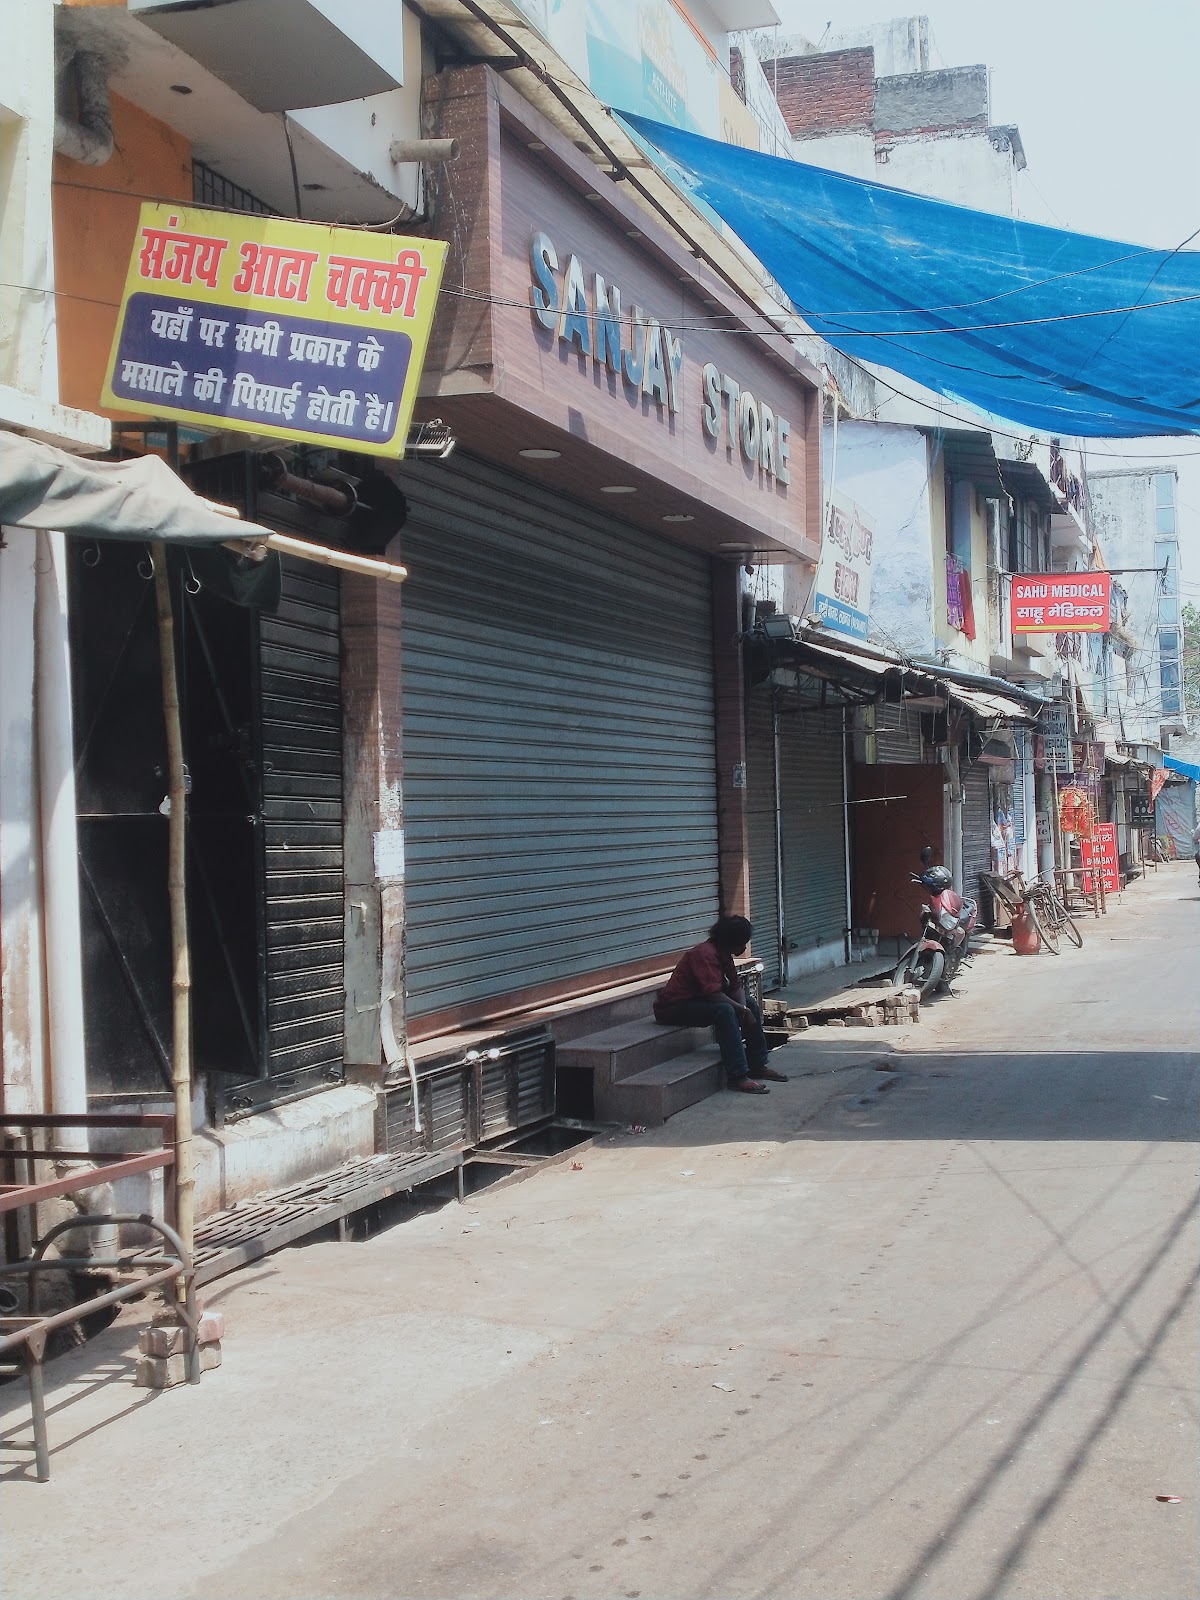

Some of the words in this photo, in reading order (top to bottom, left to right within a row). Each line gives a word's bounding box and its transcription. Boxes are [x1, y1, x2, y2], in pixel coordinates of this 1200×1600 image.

[139, 216, 228, 288] संजय
[233, 242, 318, 302] आटा
[325, 250, 428, 318] चक्की
[151, 306, 193, 342] यहाँ
[199, 317, 229, 349] पर
[234, 320, 283, 357] सभी
[288, 331, 351, 368] प्रकार
[357, 336, 385, 372] के
[529, 231, 684, 414] SANJAY
[701, 362, 791, 485] STORE
[121, 360, 187, 396] मसाले
[193, 368, 227, 404] की
[231, 372, 302, 421] पिसाई
[306, 386, 359, 427] होती
[1016, 585, 1048, 598] SAHU
[1051, 584, 1105, 598] MEDICAL
[1016, 607, 1046, 625] साहू
[1048, 602, 1105, 618] मेडिकल
[1086, 856, 1114, 866] BMBAY
